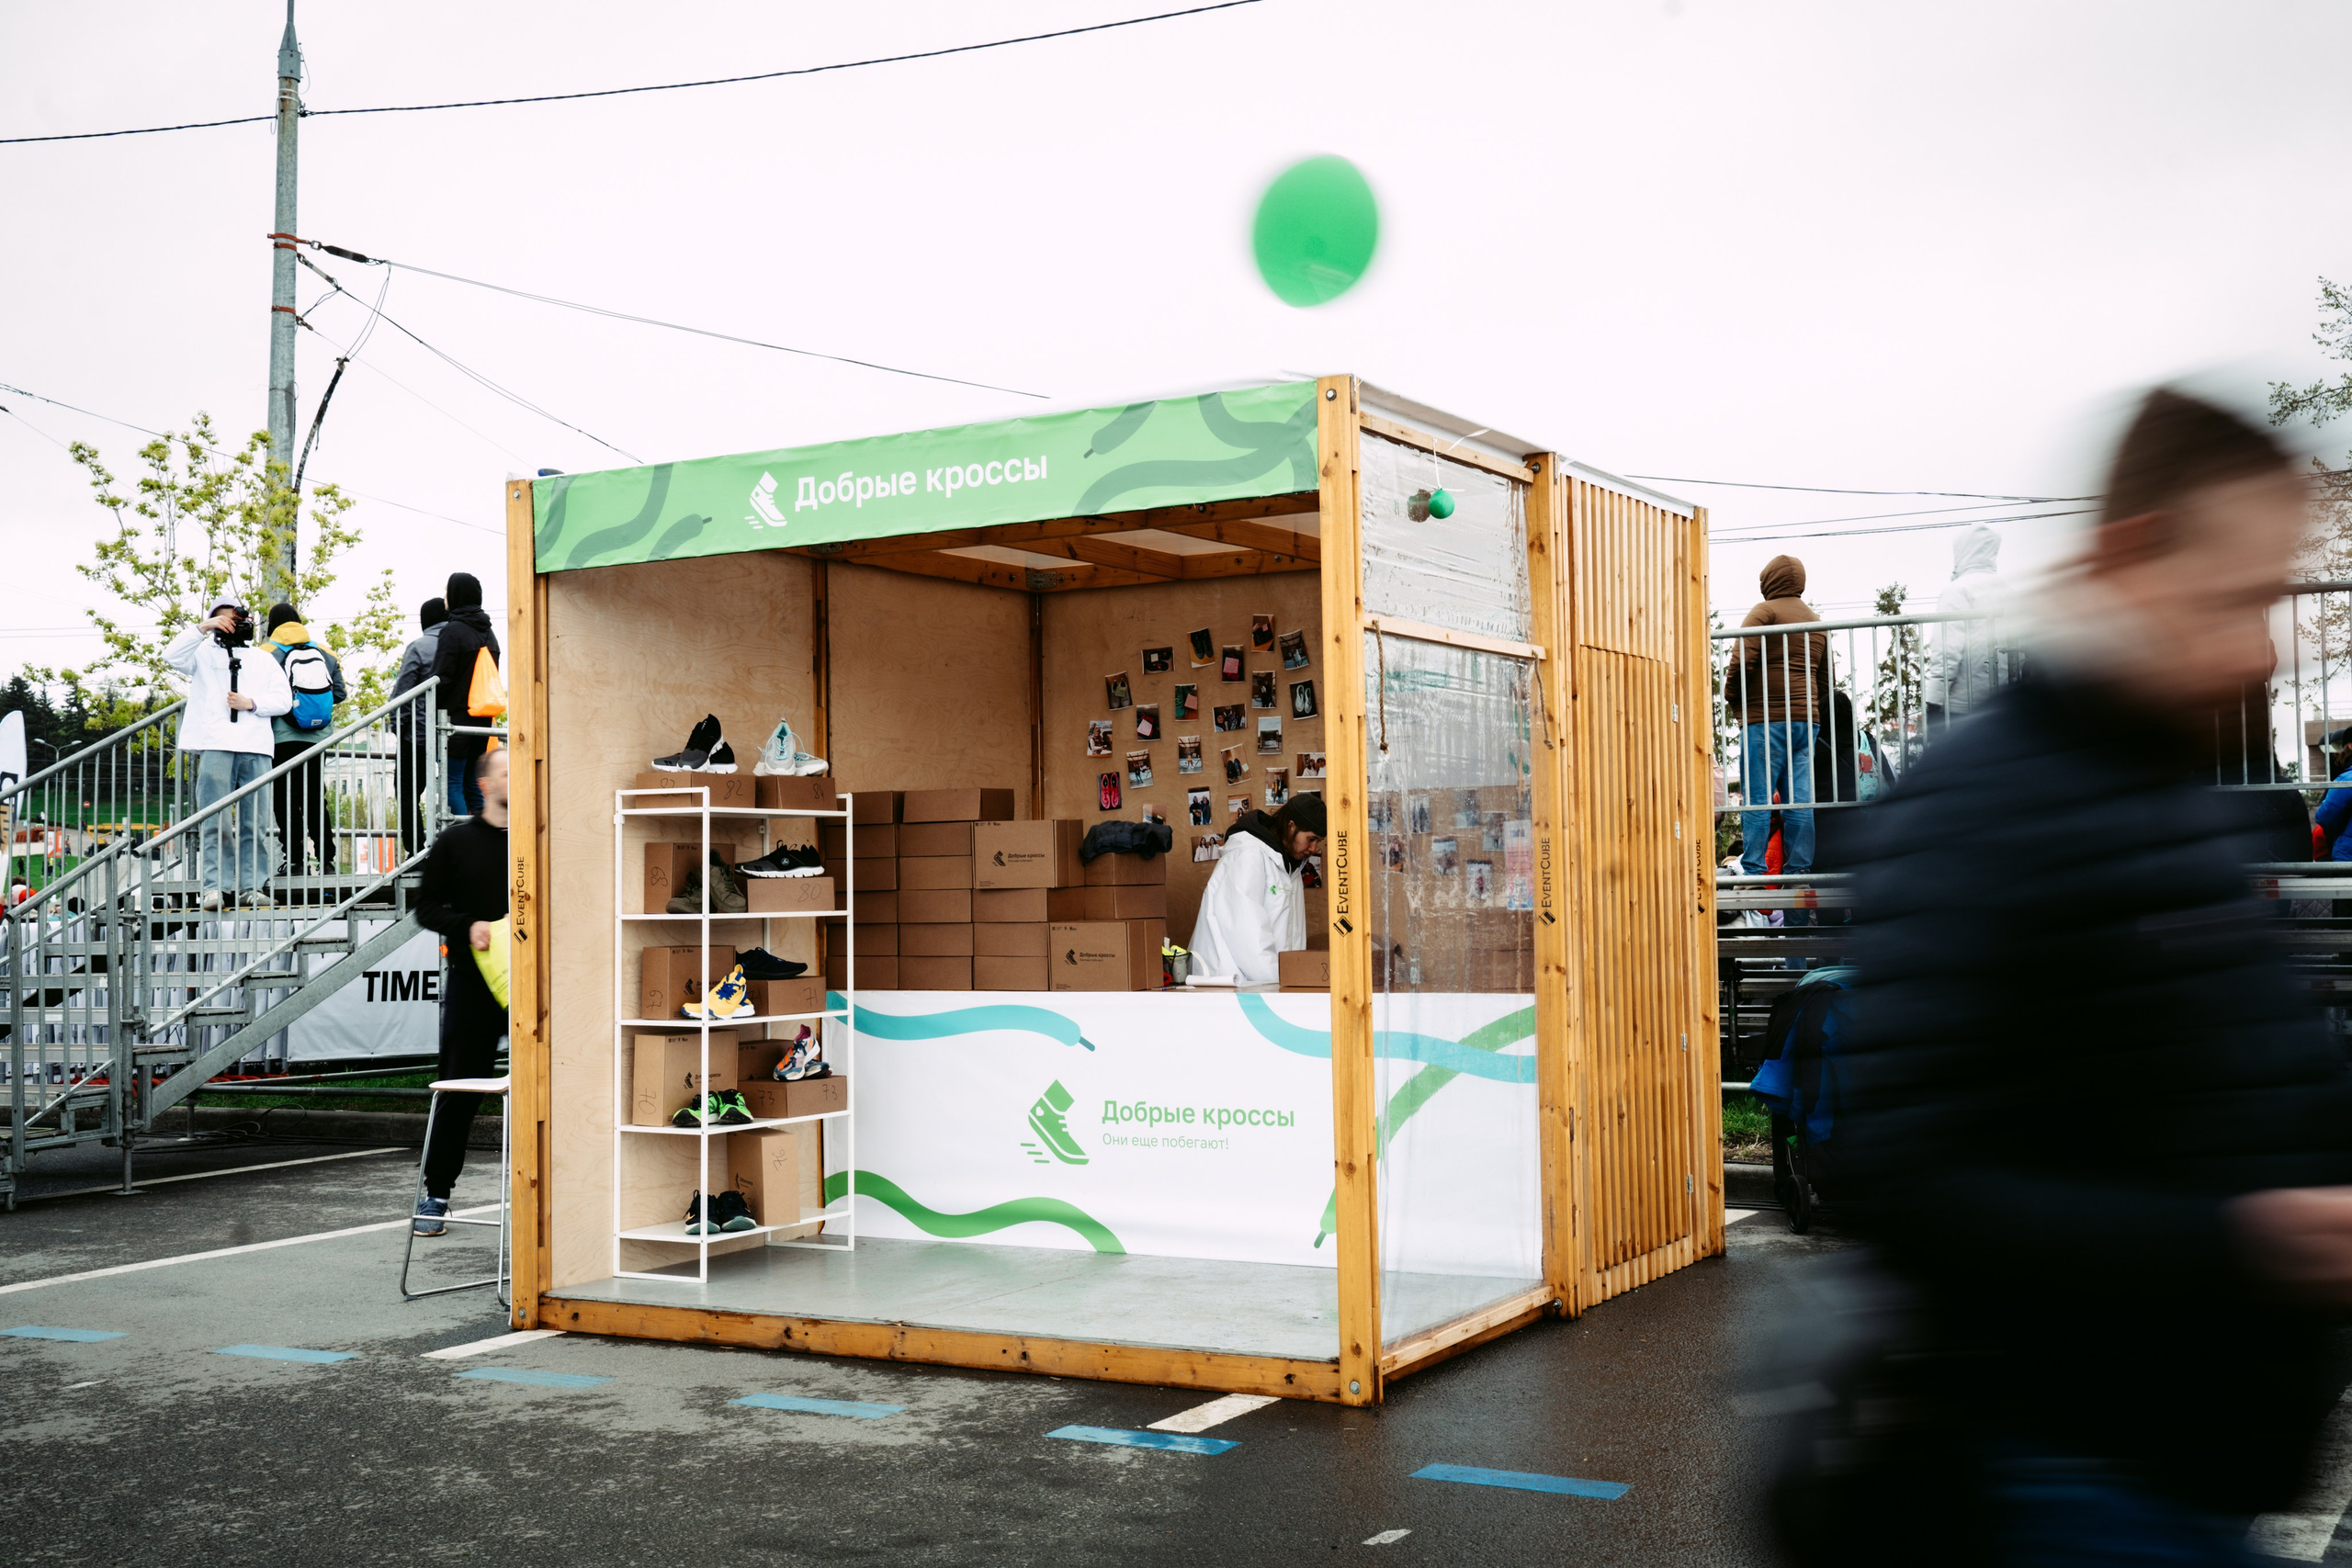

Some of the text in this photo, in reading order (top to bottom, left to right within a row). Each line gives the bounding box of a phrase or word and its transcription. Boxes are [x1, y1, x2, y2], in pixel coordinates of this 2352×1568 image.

[794, 455, 1047, 513] Добрые кроссы
[723, 780, 744, 800] 82
[812, 783, 825, 804] 84
[797, 883, 822, 903] 80
[362, 970, 440, 1003] TIME
[757, 1089, 775, 1106] 73
[1102, 1100, 1295, 1130] Добрые кроссы
[1102, 1133, 1229, 1150] Они еще побегают!
